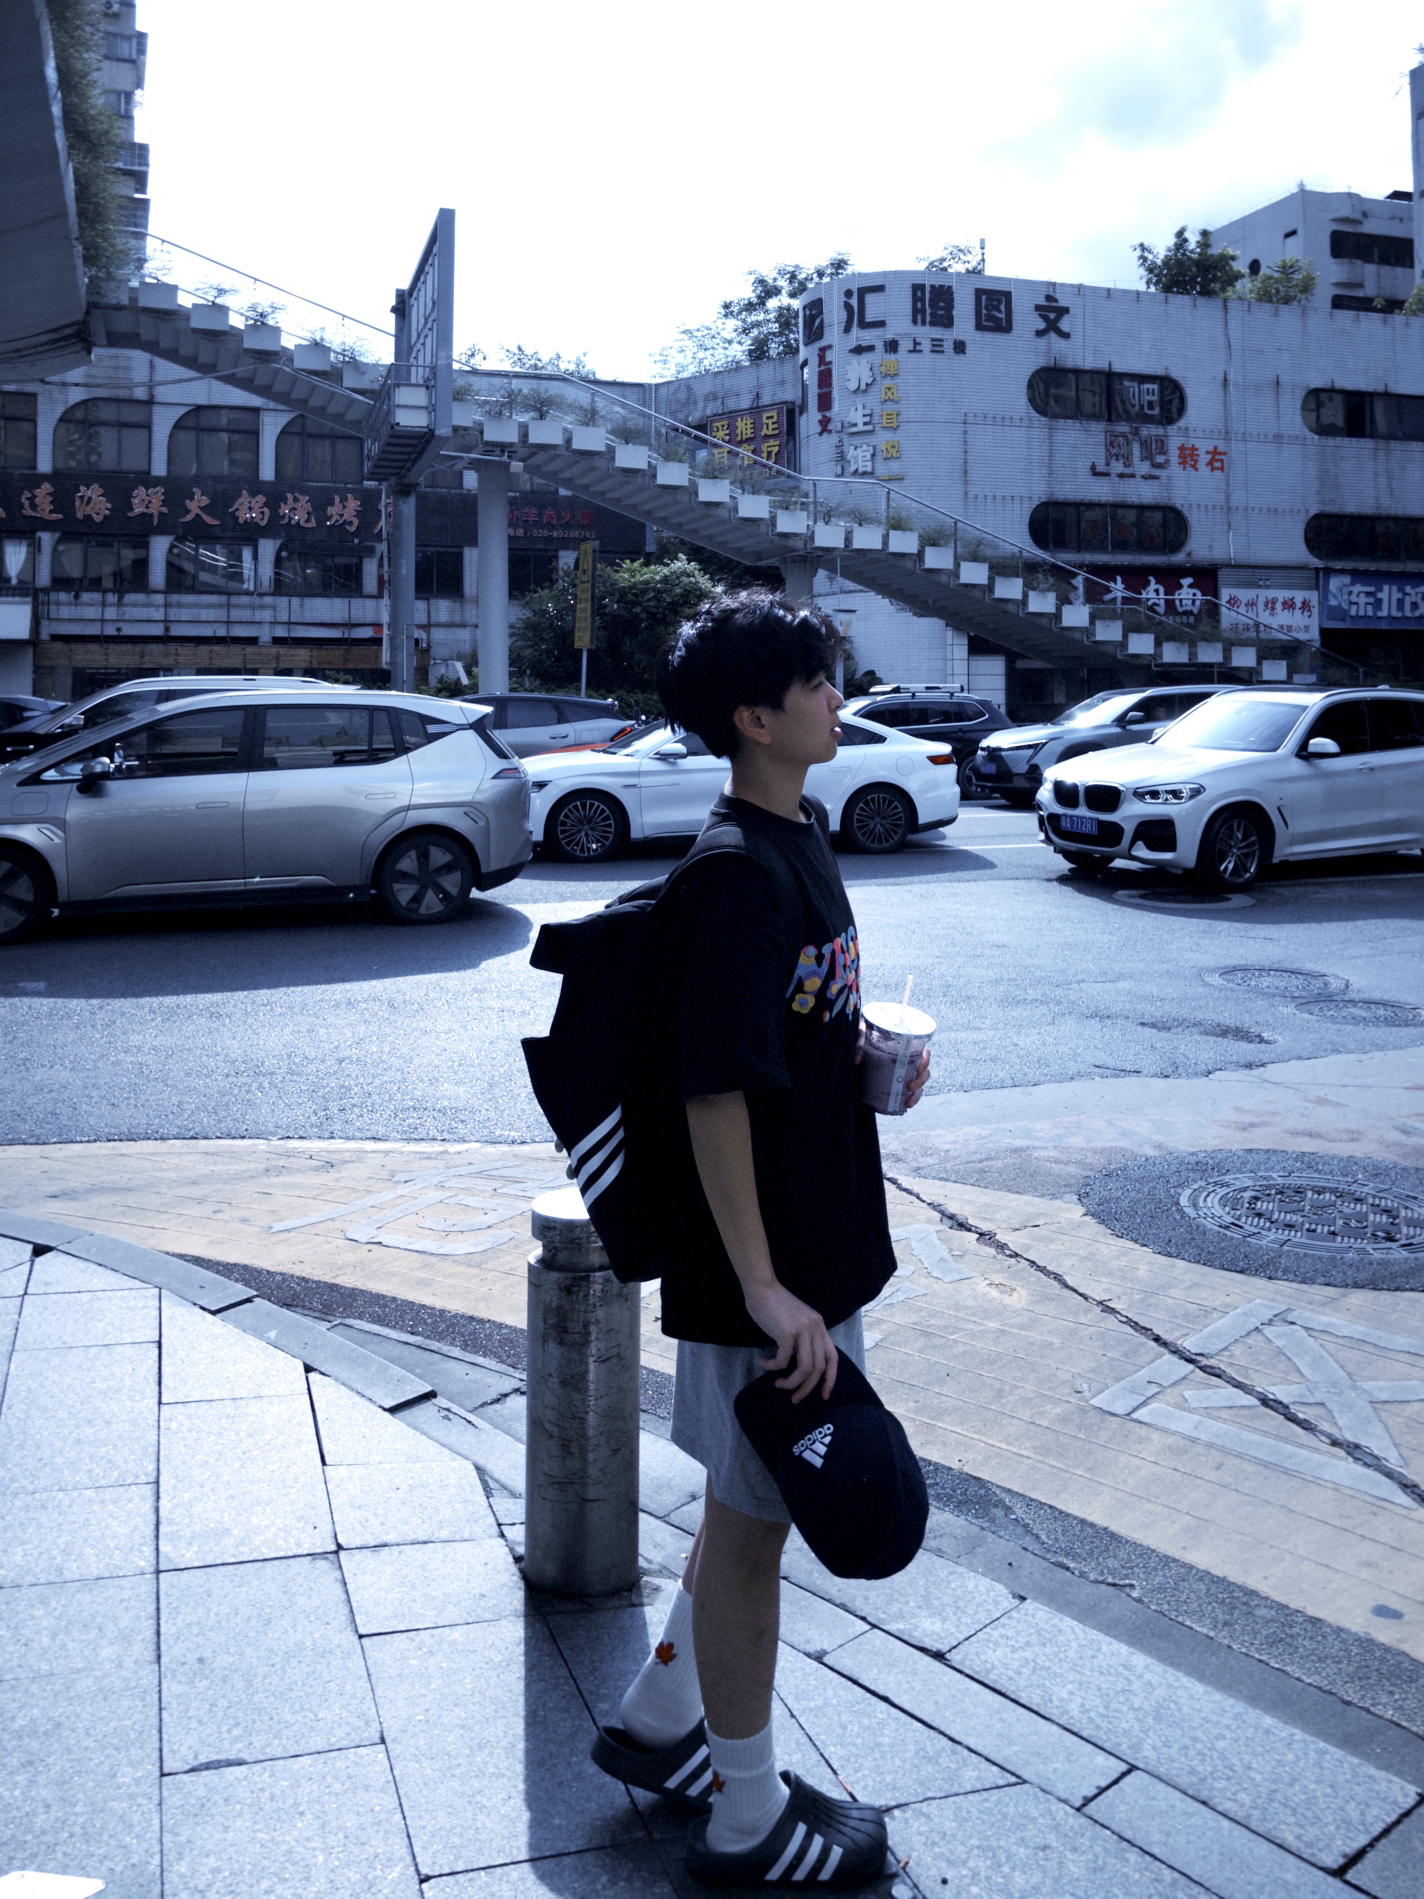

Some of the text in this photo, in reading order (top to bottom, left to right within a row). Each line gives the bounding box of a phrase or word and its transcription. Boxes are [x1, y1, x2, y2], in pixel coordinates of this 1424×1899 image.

[843, 283, 1071, 339] 汇腾图文
[883, 337, 967, 355] 请上三楼
[817, 344, 833, 436] 汇腾图文
[845, 359, 875, 475] 养生馆
[880, 358, 901, 459] 禅风耳悦
[0, 481, 393, 534] 连海鲜火锅烧烤
[1225, 592, 1316, 619] 柳州螺蛳粉
[792, 1423, 835, 1456] adidas
